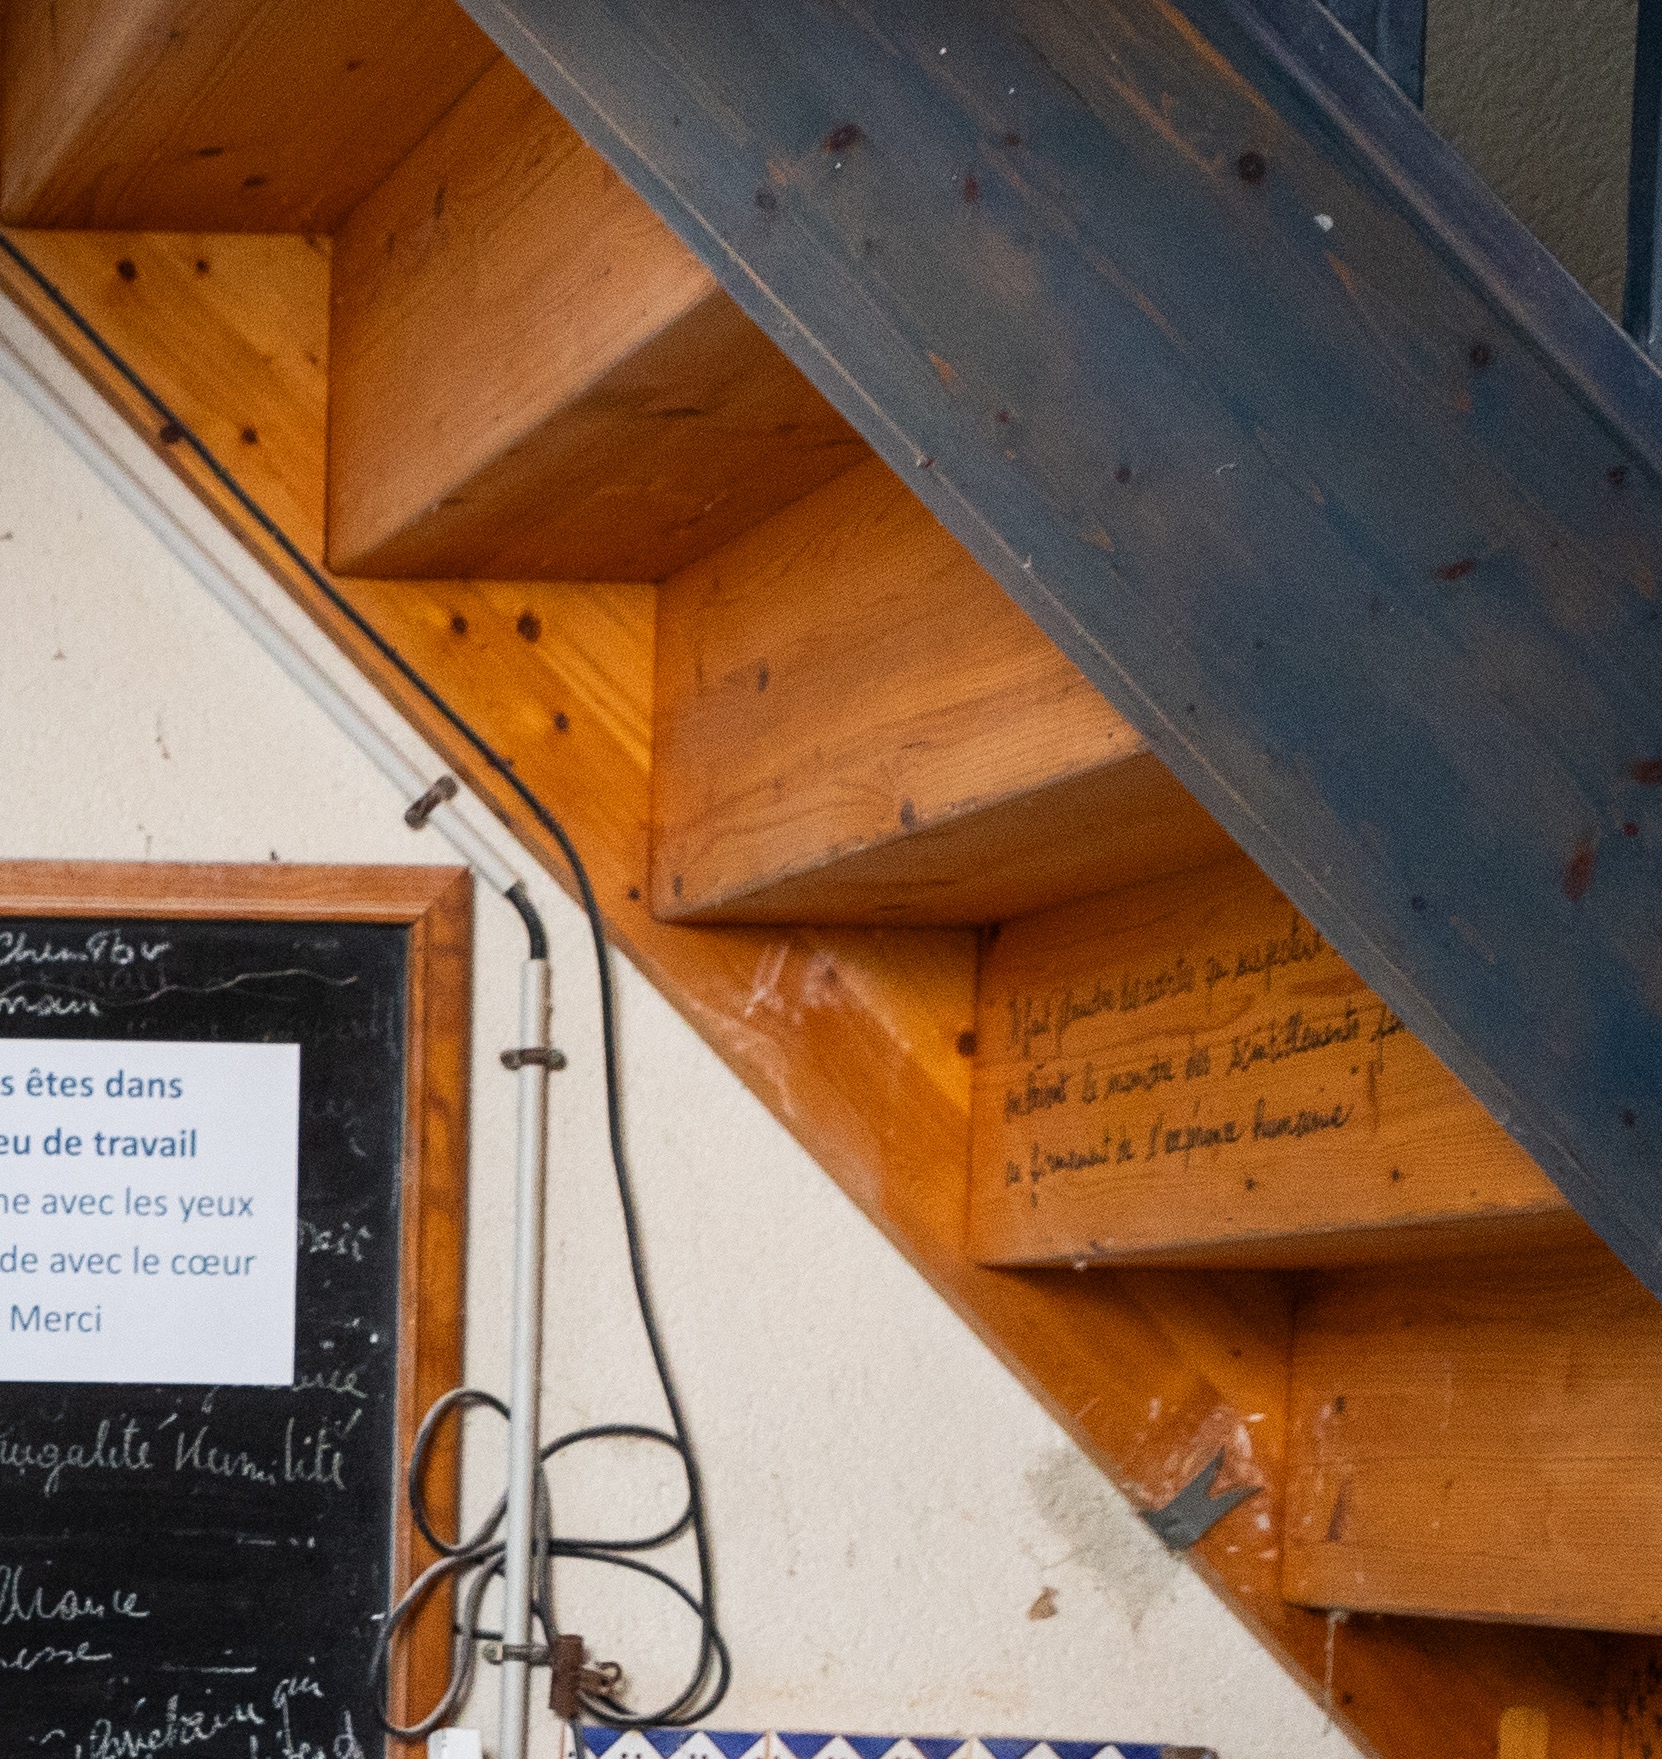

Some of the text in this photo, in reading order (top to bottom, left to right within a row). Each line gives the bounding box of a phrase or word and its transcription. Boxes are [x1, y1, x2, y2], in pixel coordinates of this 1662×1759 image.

[25, 1066, 94, 1099] êtes
[104, 1068, 183, 1100] dans
[42, 1126, 83, 1158] de
[93, 1127, 197, 1159] travail
[41, 1191, 113, 1218] avec
[125, 1186, 168, 1217] les
[179, 1192, 254, 1224] yeux
[49, 1250, 121, 1277] avec
[133, 1245, 160, 1276] le
[171, 1252, 256, 1277] cœur
[10, 1303, 101, 1334] Merci
